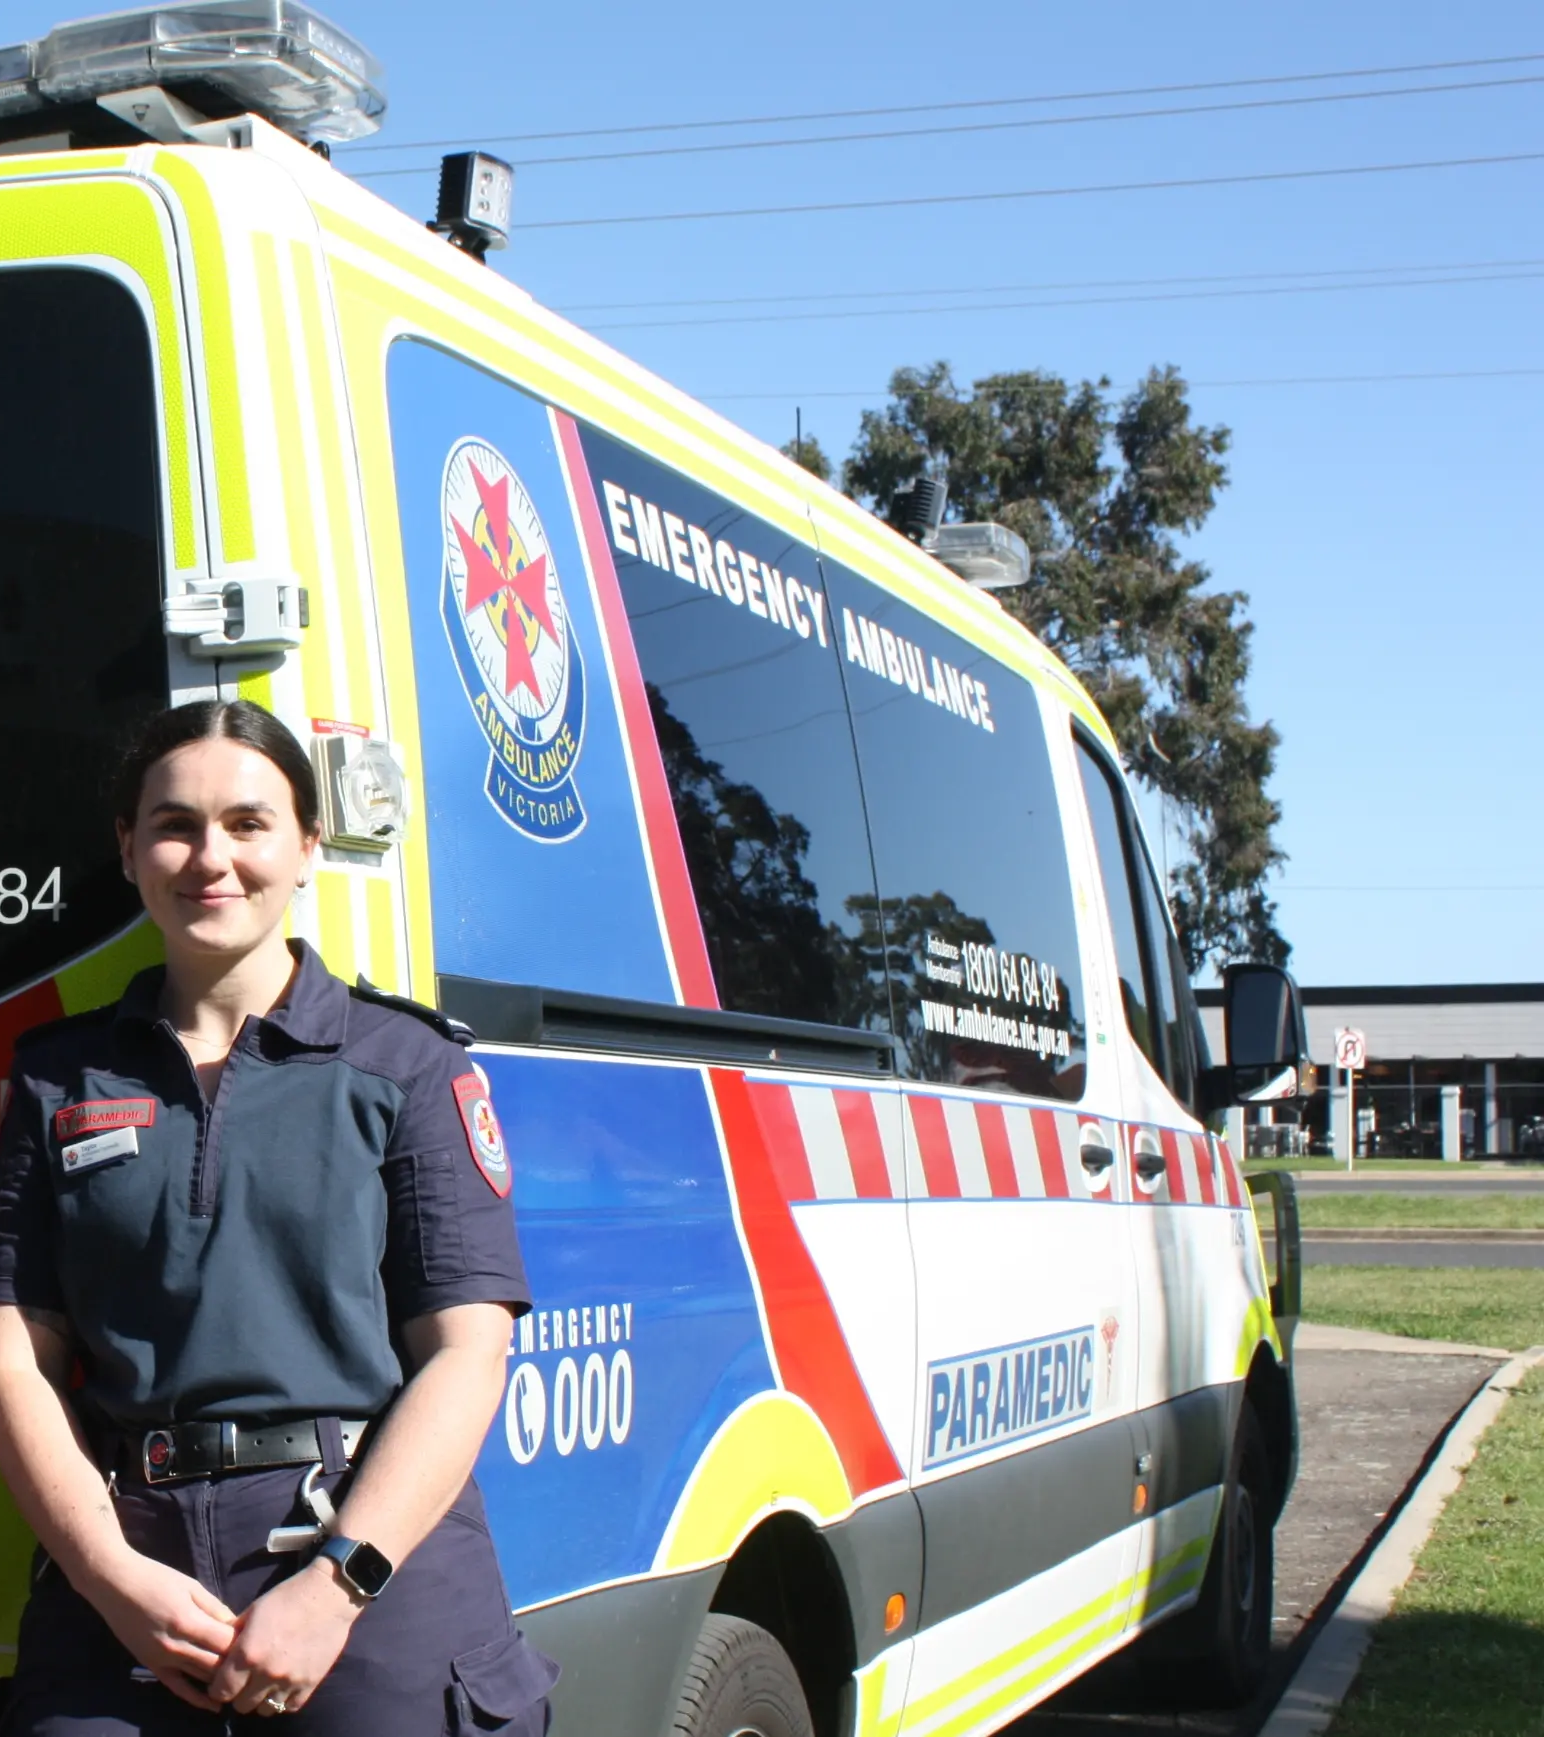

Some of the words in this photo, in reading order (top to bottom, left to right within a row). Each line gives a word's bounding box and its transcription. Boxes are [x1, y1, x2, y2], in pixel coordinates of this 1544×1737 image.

[602, 480, 828, 648] EMERGENCY
[843, 607, 995, 734] AMBULANCE
[474, 691, 576, 785] AMBULANCE
[496, 773, 576, 827] VICTORIA
[926, 959, 962, 988] Membership
[927, 934, 959, 960] Ambulance
[961, 940, 999, 998] 1800
[1000, 951, 1020, 1004] 64
[1020, 956, 1040, 1008] 84
[1040, 962, 1060, 1012] 84
[920, 999, 1070, 1061] www.ambulance.vic.gov.au
[77, 1110, 146, 1125] PARAMEDIC
[553, 1348, 633, 1457] 000
[927, 1335, 1092, 1458] PARAMEDIC
